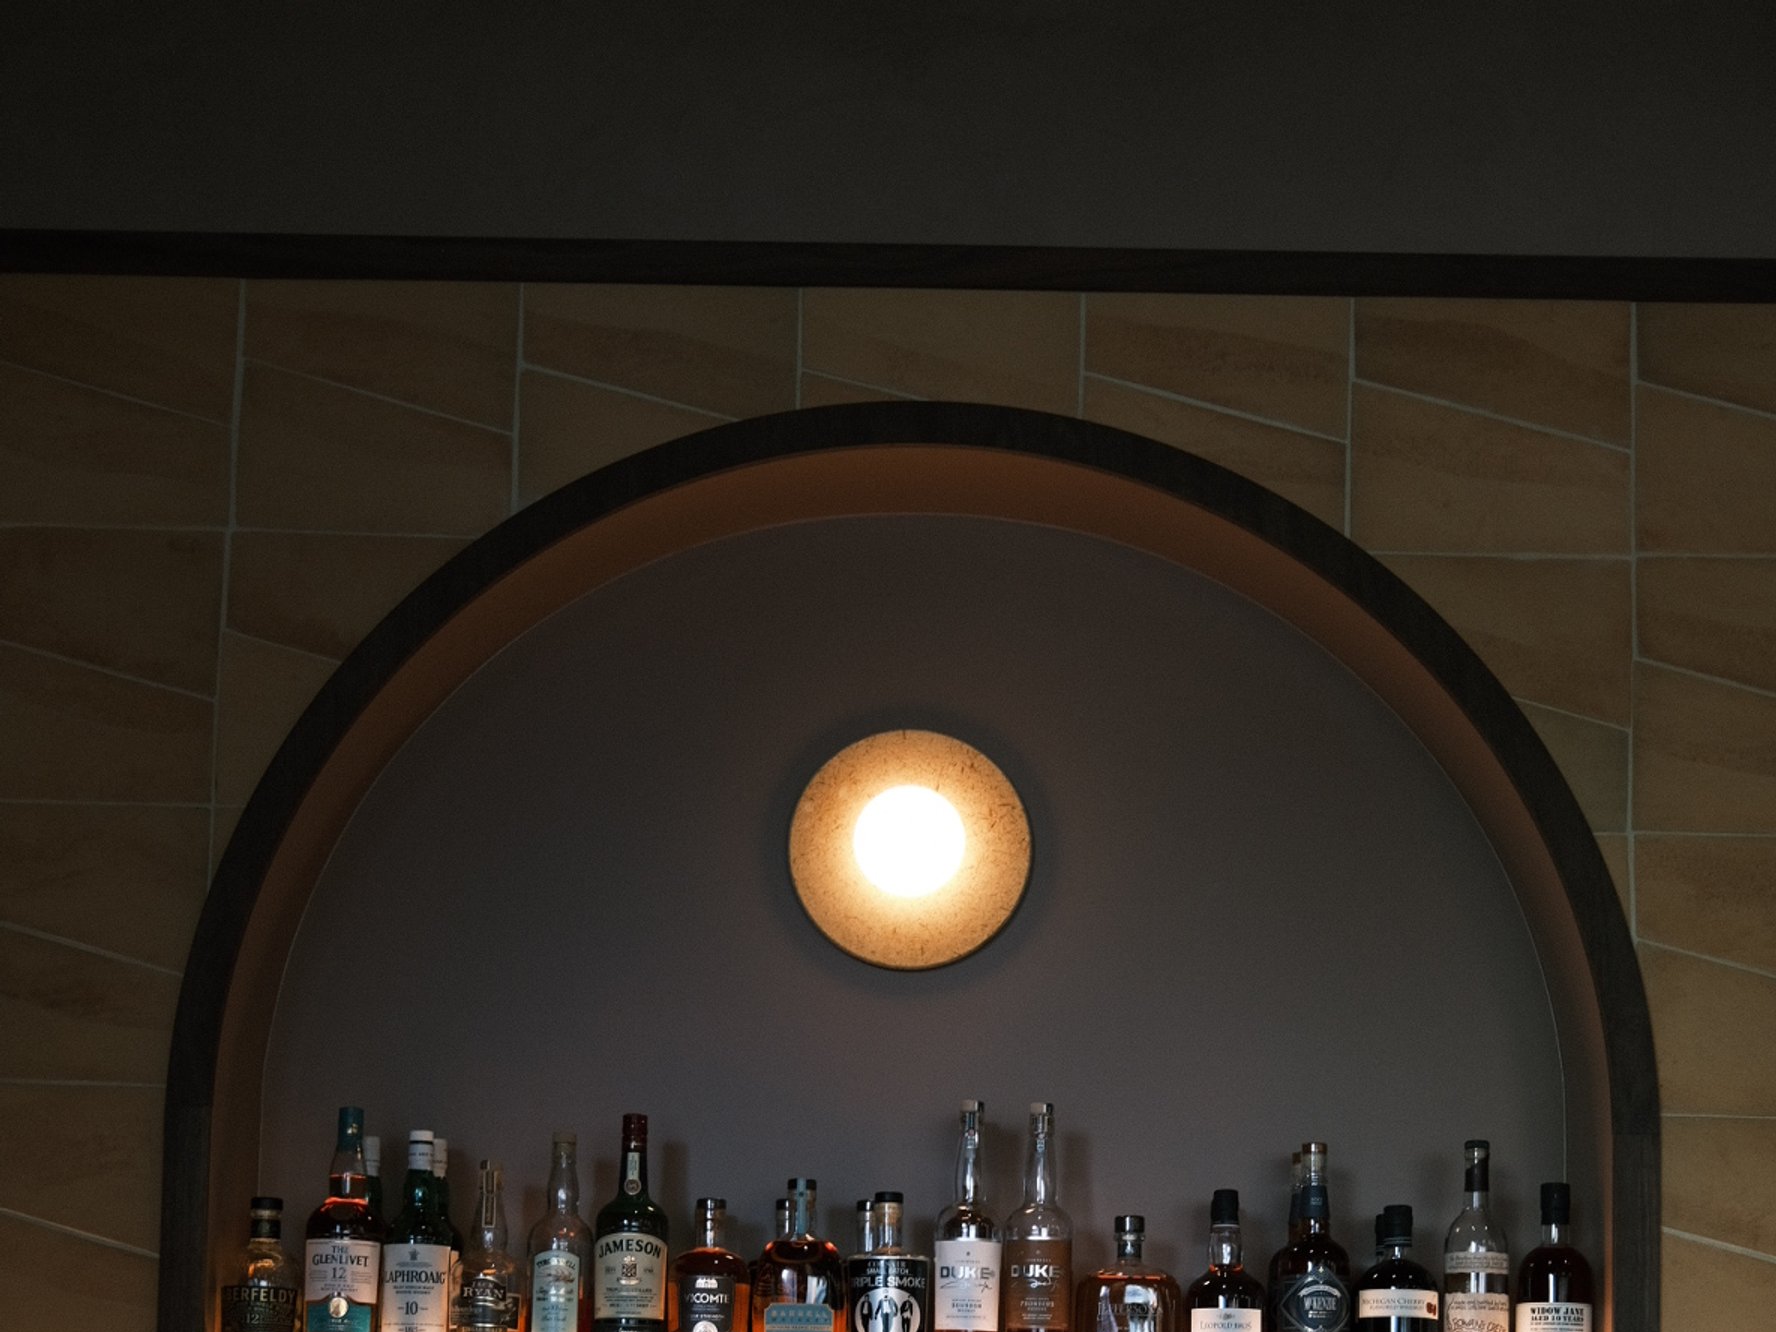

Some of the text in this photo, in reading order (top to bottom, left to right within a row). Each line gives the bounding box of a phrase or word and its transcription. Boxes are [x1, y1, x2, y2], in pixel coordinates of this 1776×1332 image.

[598, 1238, 662, 1258] JAMESON
[312, 1253, 369, 1267] GLENLIVET
[332, 1266, 346, 1279] 12
[385, 1270, 447, 1285] LAPHROAIG
[940, 1265, 990, 1279] DUKE
[1011, 1263, 1060, 1278] DUKE
[887, 1275, 926, 1288] SMOKE
[463, 1286, 504, 1299] RYAN
[405, 1301, 419, 1315] 10
[1531, 1307, 1584, 1316] WIDOW JANE
[1563, 1315, 1584, 1323] YEARS
